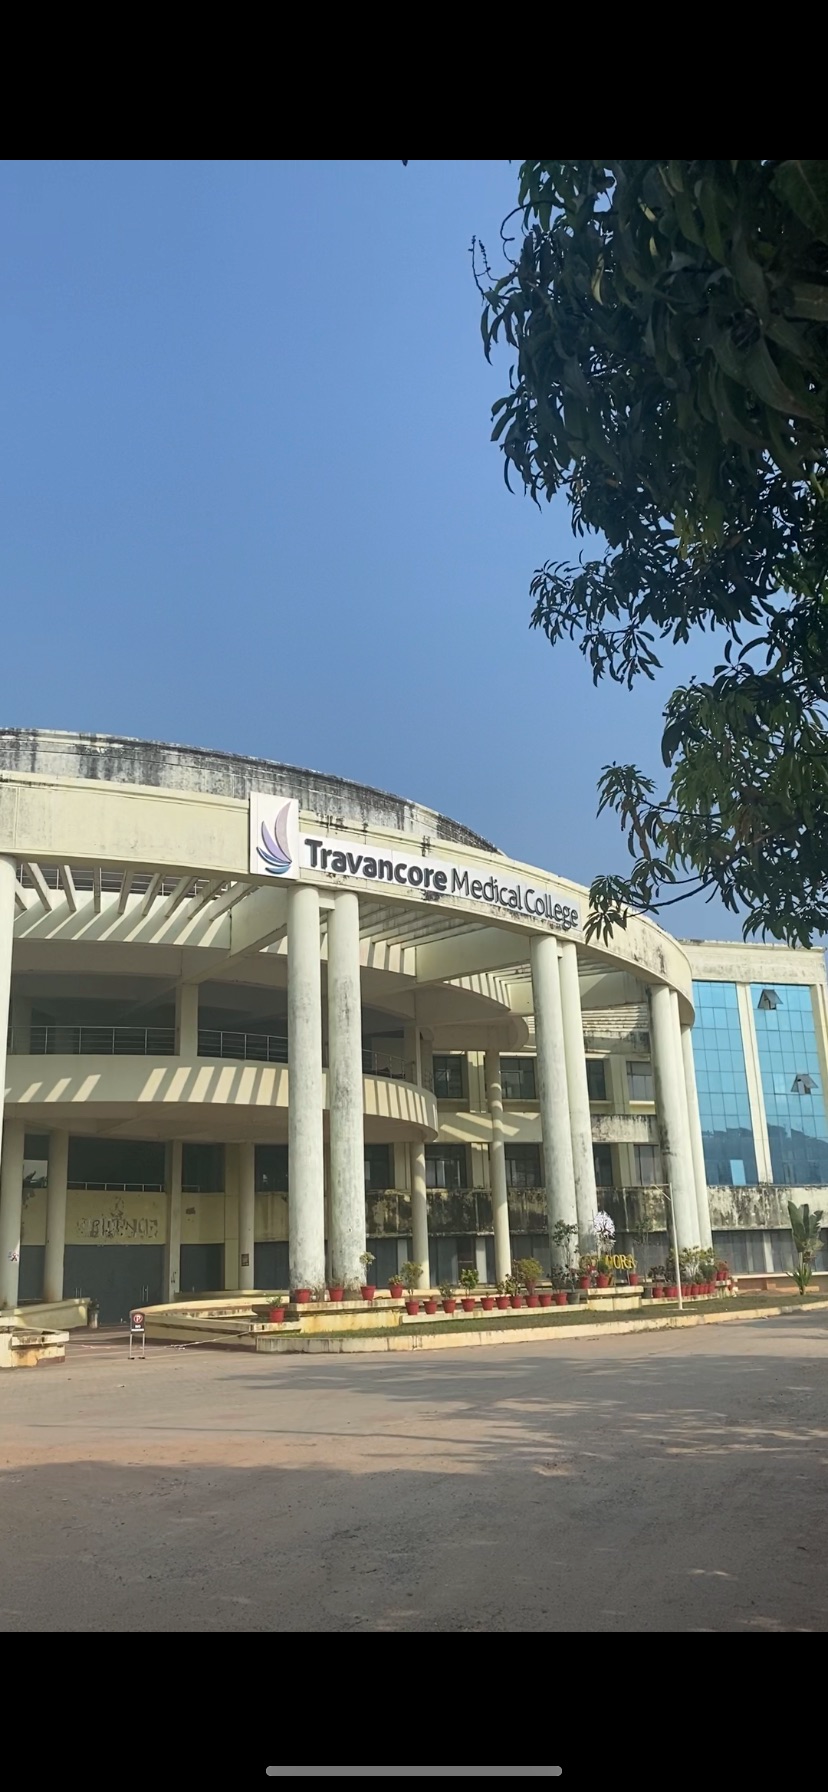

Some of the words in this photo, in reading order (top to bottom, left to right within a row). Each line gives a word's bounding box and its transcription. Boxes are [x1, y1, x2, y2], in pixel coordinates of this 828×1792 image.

[304, 838, 448, 892] Travancore
[450, 867, 523, 910] Medical
[524, 888, 579, 930] College
